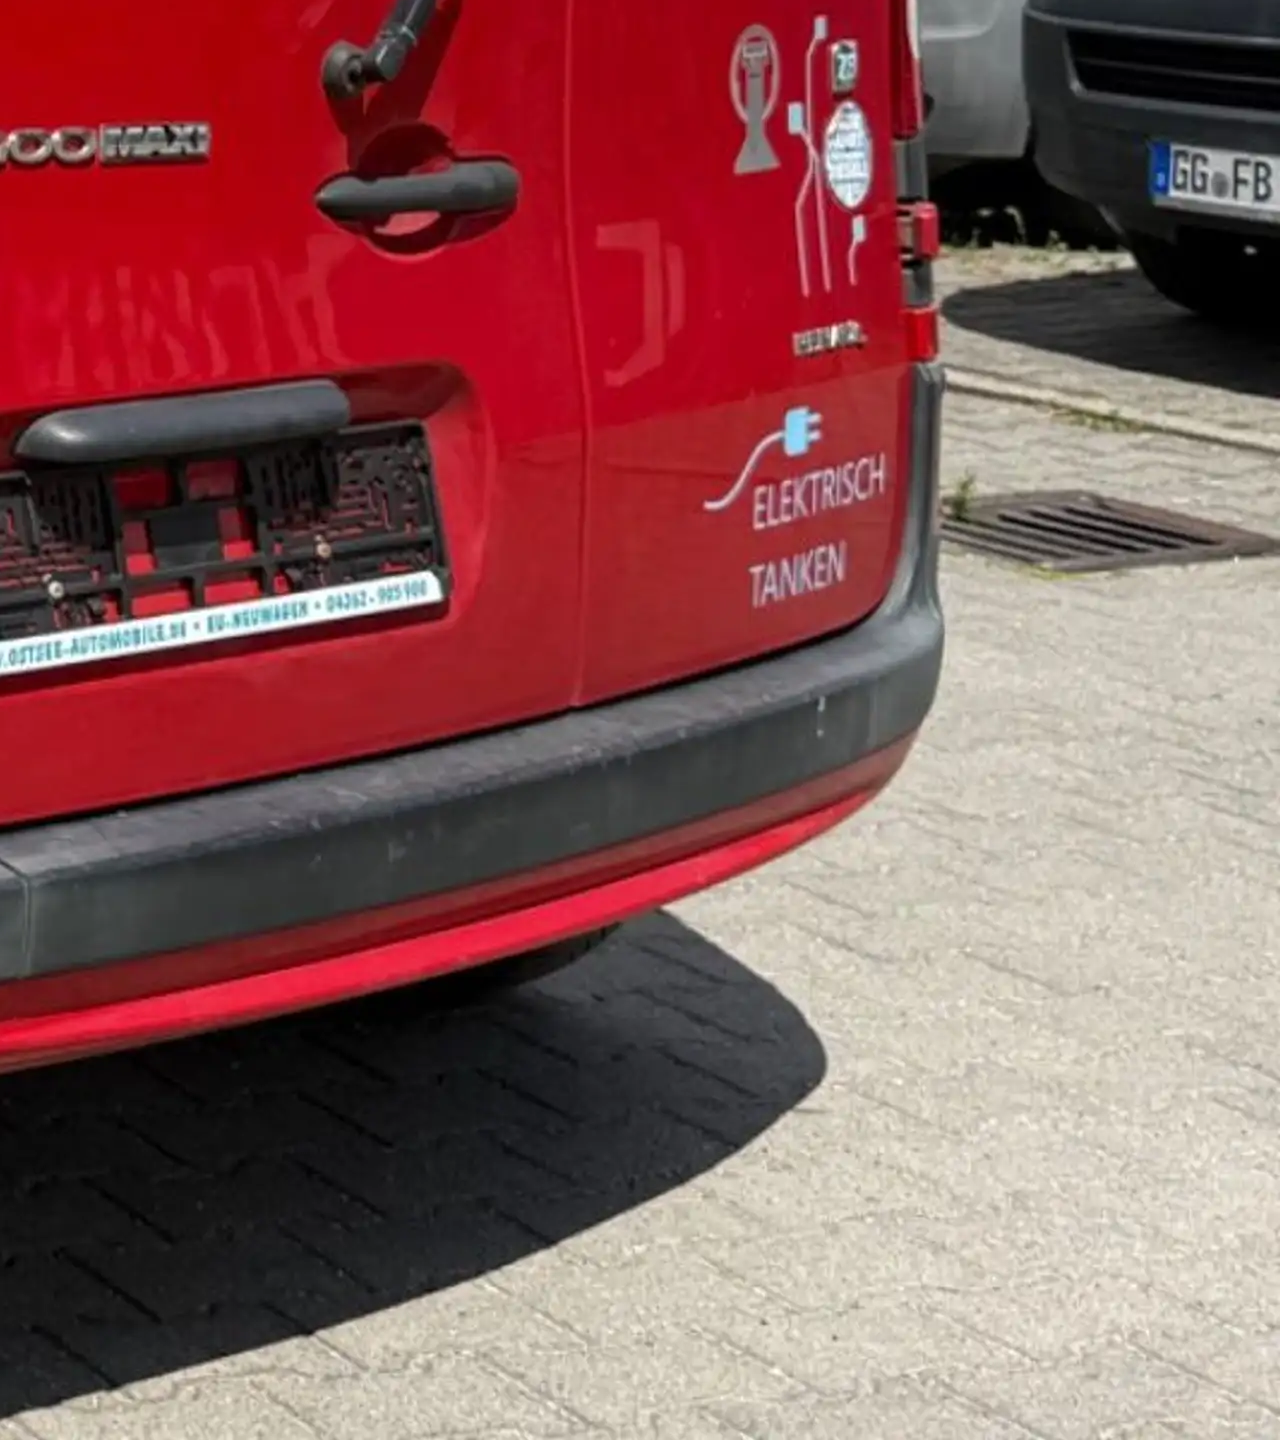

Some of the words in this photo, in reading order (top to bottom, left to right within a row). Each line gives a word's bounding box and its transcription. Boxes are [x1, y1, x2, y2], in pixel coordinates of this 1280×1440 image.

[1172, 149, 1210, 194] GG
[1232, 157, 1273, 203] FB
[752, 451, 886, 531] ELEKTRISCH
[747, 539, 848, 609] TANKEN
